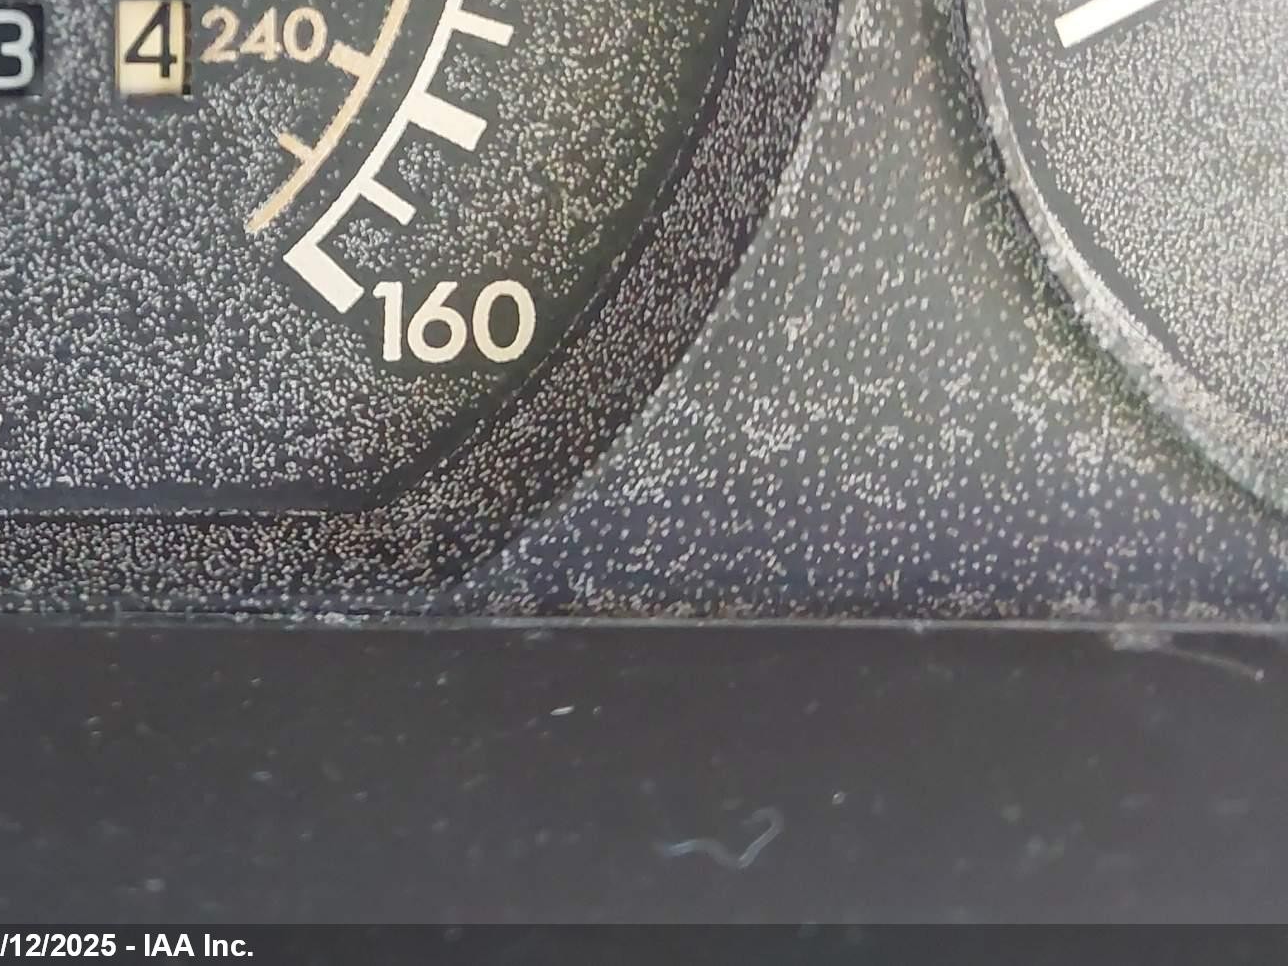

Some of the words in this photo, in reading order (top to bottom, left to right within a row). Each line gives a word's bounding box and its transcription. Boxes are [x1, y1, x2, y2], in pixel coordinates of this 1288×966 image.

[123, 0, 179, 80] 4
[201, 7, 328, 63] 240
[372, 280, 536, 364] 160
